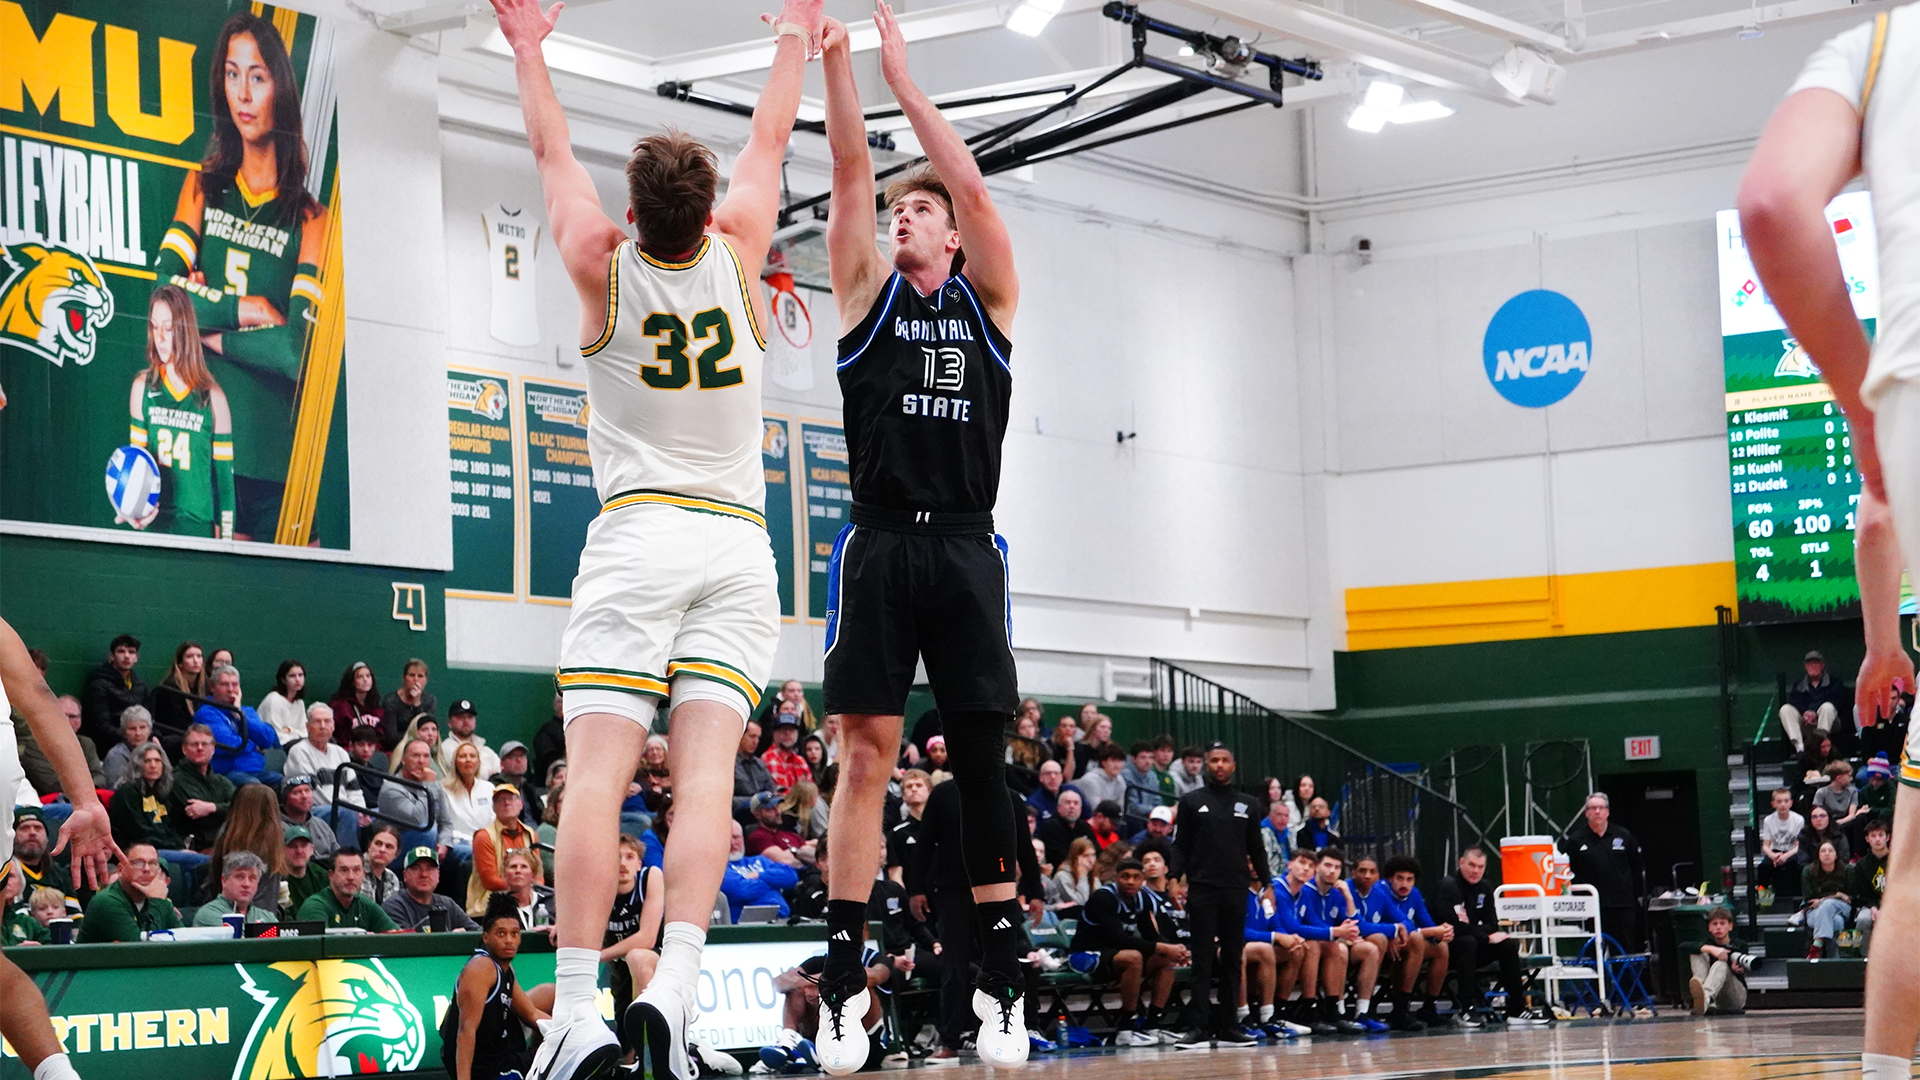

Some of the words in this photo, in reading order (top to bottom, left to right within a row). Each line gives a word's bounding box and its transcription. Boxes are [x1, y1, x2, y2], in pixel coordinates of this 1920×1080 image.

[0, 136, 147, 266] LEYBALL
[204, 207, 290, 246] NORTHERN
[497, 222, 526, 239] METRO
[205, 221, 285, 258] MICHIGAN
[224, 247, 251, 297] 5
[505, 245, 520, 281] 2
[639, 306, 745, 391] 32
[921, 346, 966, 391] 13
[1495, 341, 1589, 382] NCAA
[529, 394, 578, 406] NORTHERN
[1787, 391, 1812, 399] NAME
[148, 406, 204, 425] NORTHERN
[536, 403, 578, 415] MICHIGAN
[902, 394, 971, 422] STATE
[1732, 414, 1740, 425] 4
[1823, 403, 1833, 416] 6
[150, 415, 201, 433] MICHIGAN
[481, 424, 510, 441] SEASON
[1730, 431, 1743, 443] 10
[1745, 427, 1779, 441] Polite
[1824, 421, 1834, 434] 0
[1842, 421, 1849, 432] 1
[157, 427, 191, 471] 24
[530, 431, 555, 447] GLIAC
[1732, 447, 1745, 458] 12
[1746, 443, 1781, 457] Miller
[1825, 438, 1835, 450] 0
[1842, 436, 1850, 448] 0
[546, 448, 592, 468] CHAMPION
[1732, 464, 1746, 476] 25
[1747, 460, 1783, 475] Kuehl
[1826, 455, 1836, 468] 3
[1843, 454, 1852, 466] 0
[1733, 482, 1747, 494] 32
[1748, 477, 1788, 492] Dudek
[1827, 472, 1837, 485] 0
[1845, 472, 1852, 484] 1
[1748, 502, 1773, 515] FG%
[1798, 498, 1823, 510] 3P%
[1748, 519, 1774, 539] 60
[1794, 514, 1831, 534] 100
[1750, 546, 1774, 559] TOL
[1801, 541, 1830, 554] STLS
[1756, 564, 1770, 582] 4
[1810, 559, 1823, 578] 1
[392, 582, 427, 631] 4
[1631, 739, 1651, 757] EXIT
[1553, 901, 1586, 912] GATORADE
